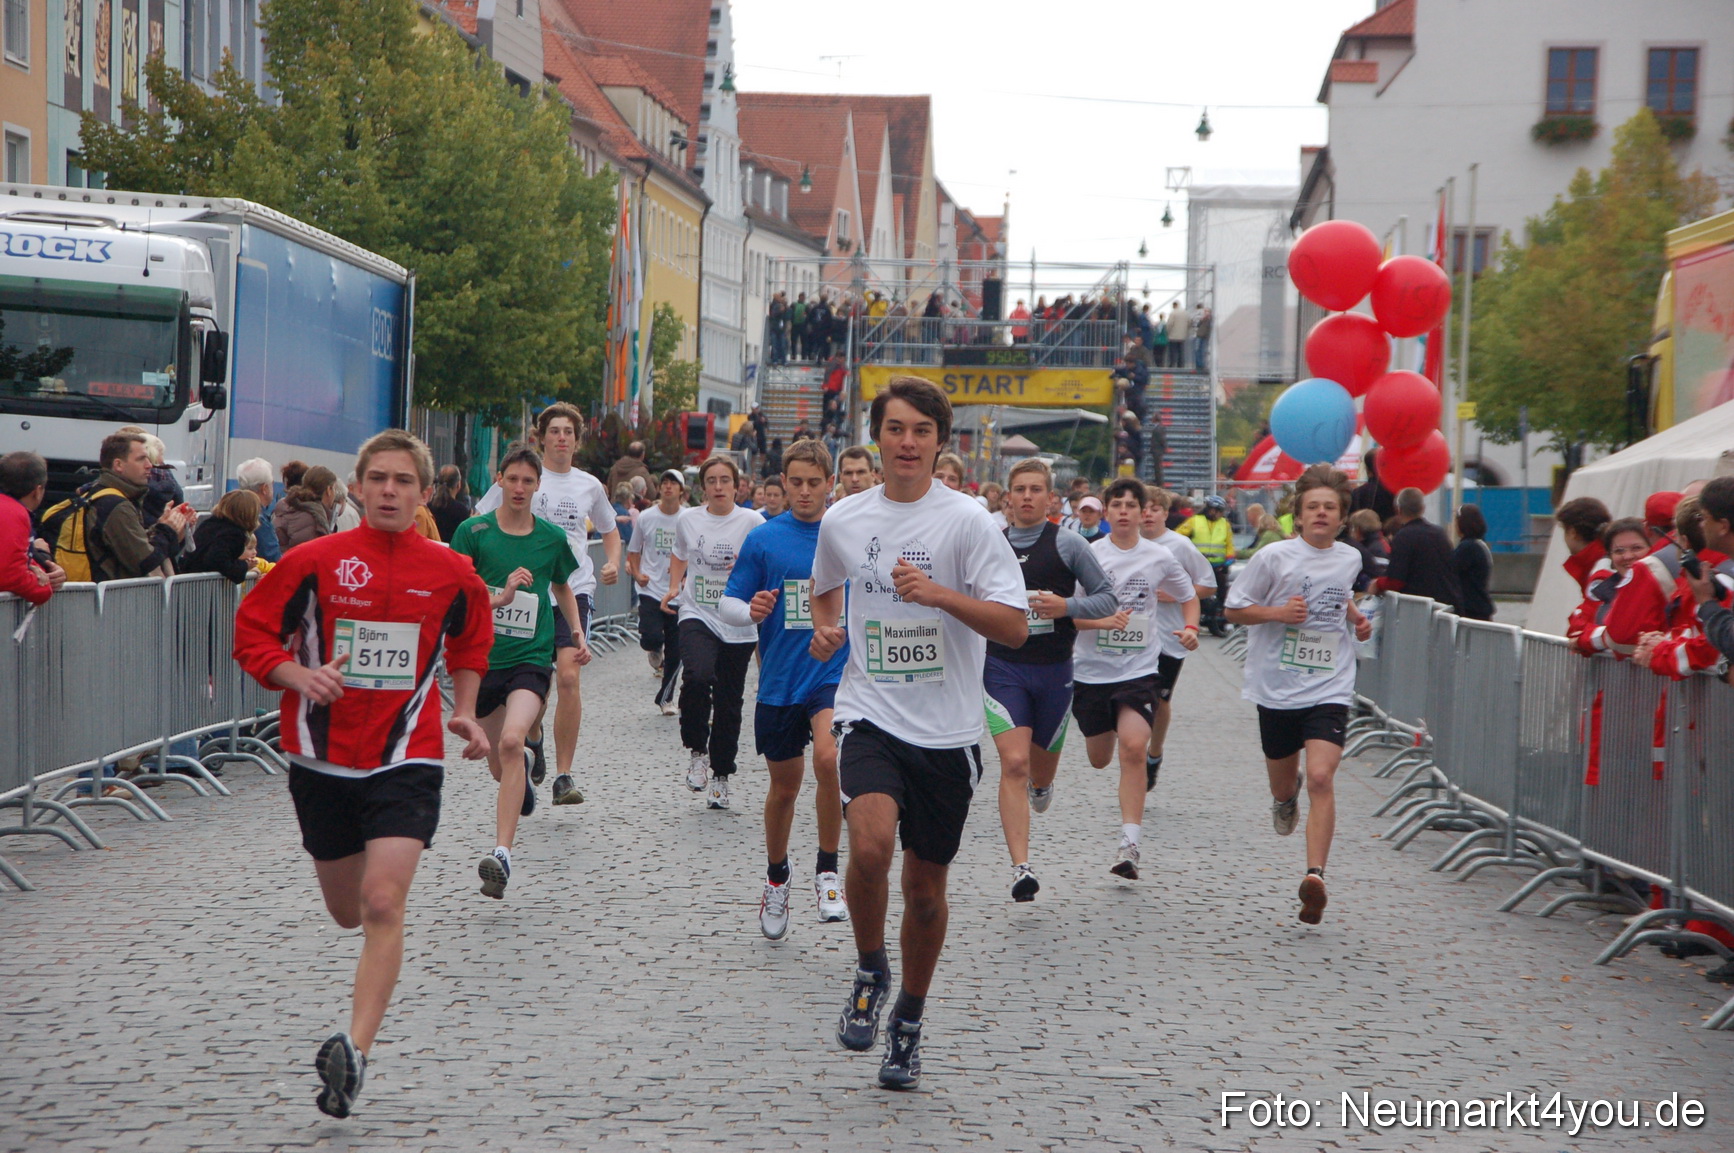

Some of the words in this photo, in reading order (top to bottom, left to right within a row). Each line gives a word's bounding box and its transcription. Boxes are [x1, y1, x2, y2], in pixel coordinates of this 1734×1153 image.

[943, 373, 1030, 395] START
[865, 581, 878, 594] 9.
[880, 586, 898, 594] Neu
[495, 608, 531, 624] 5171
[358, 627, 389, 643] Björn
[884, 625, 938, 639] Maximilian
[1111, 630, 1144, 642] 5229
[1300, 632, 1322, 644] Daniel
[337, 644, 344, 655] S
[358, 648, 411, 668] 5179
[869, 643, 875, 654] S
[887, 643, 938, 664] 5063
[1298, 647, 1332, 663] 5113
